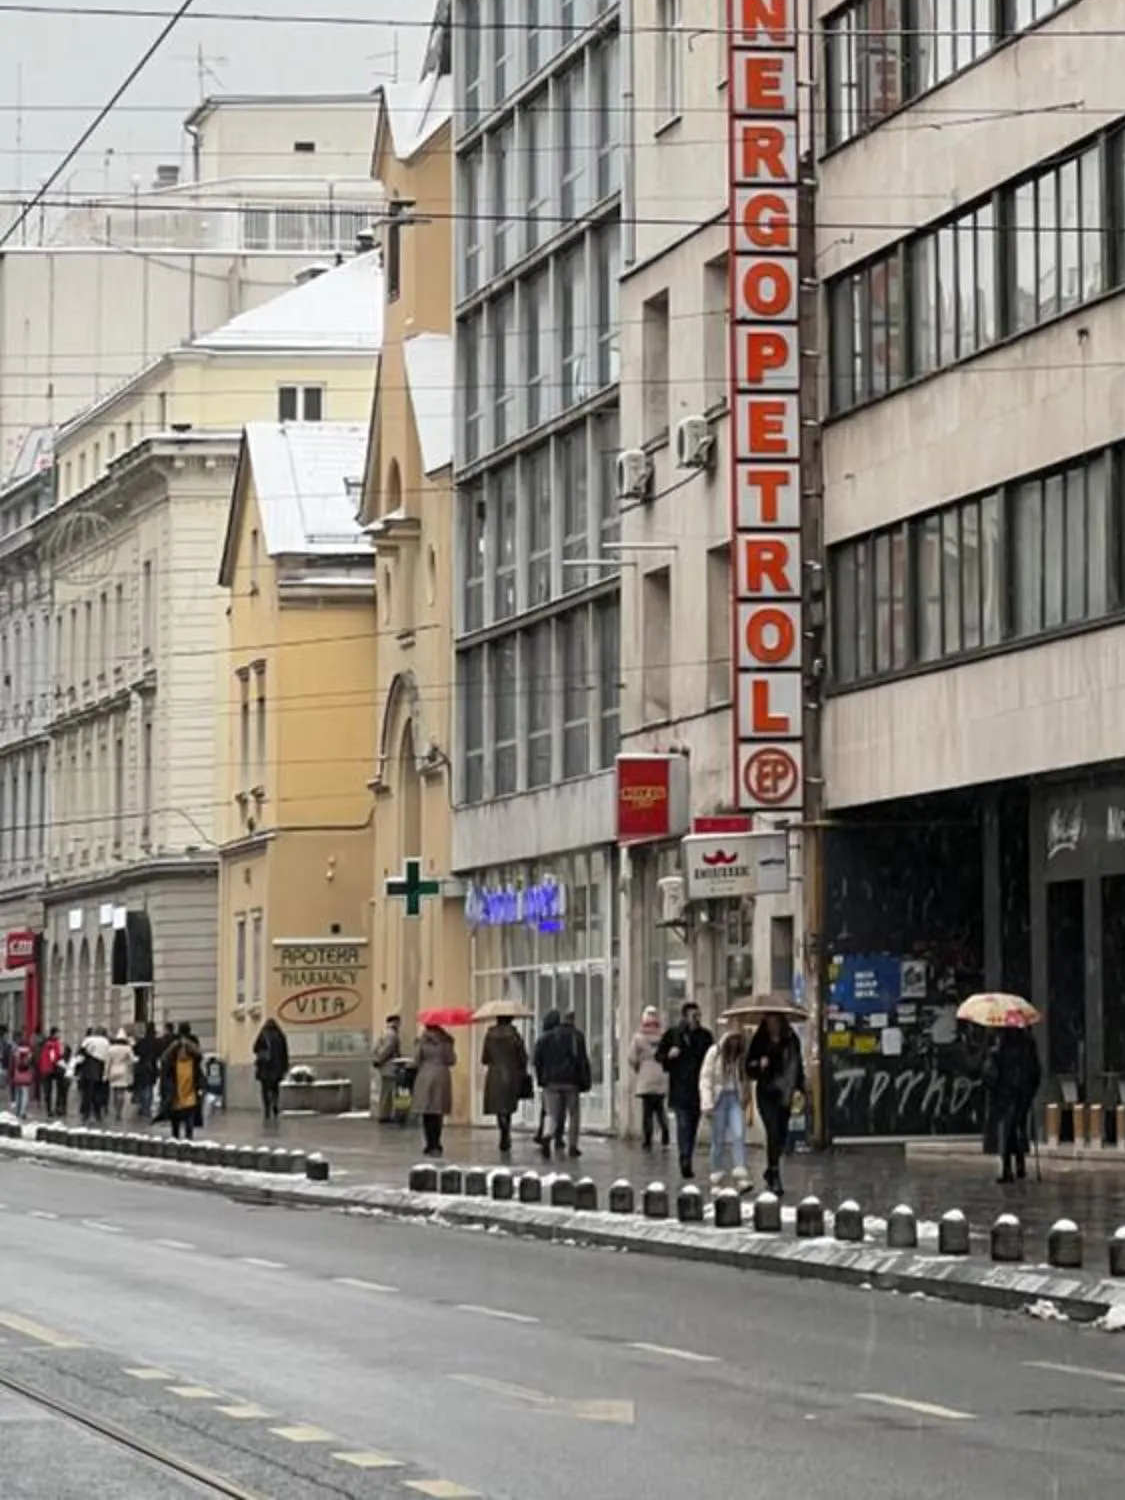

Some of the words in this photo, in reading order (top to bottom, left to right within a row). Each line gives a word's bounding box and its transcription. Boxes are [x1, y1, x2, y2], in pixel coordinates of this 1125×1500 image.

[281, 947, 360, 965] APOTEKA
[281, 970, 357, 987] PHARMACY
[295, 996, 346, 1014] VITA
